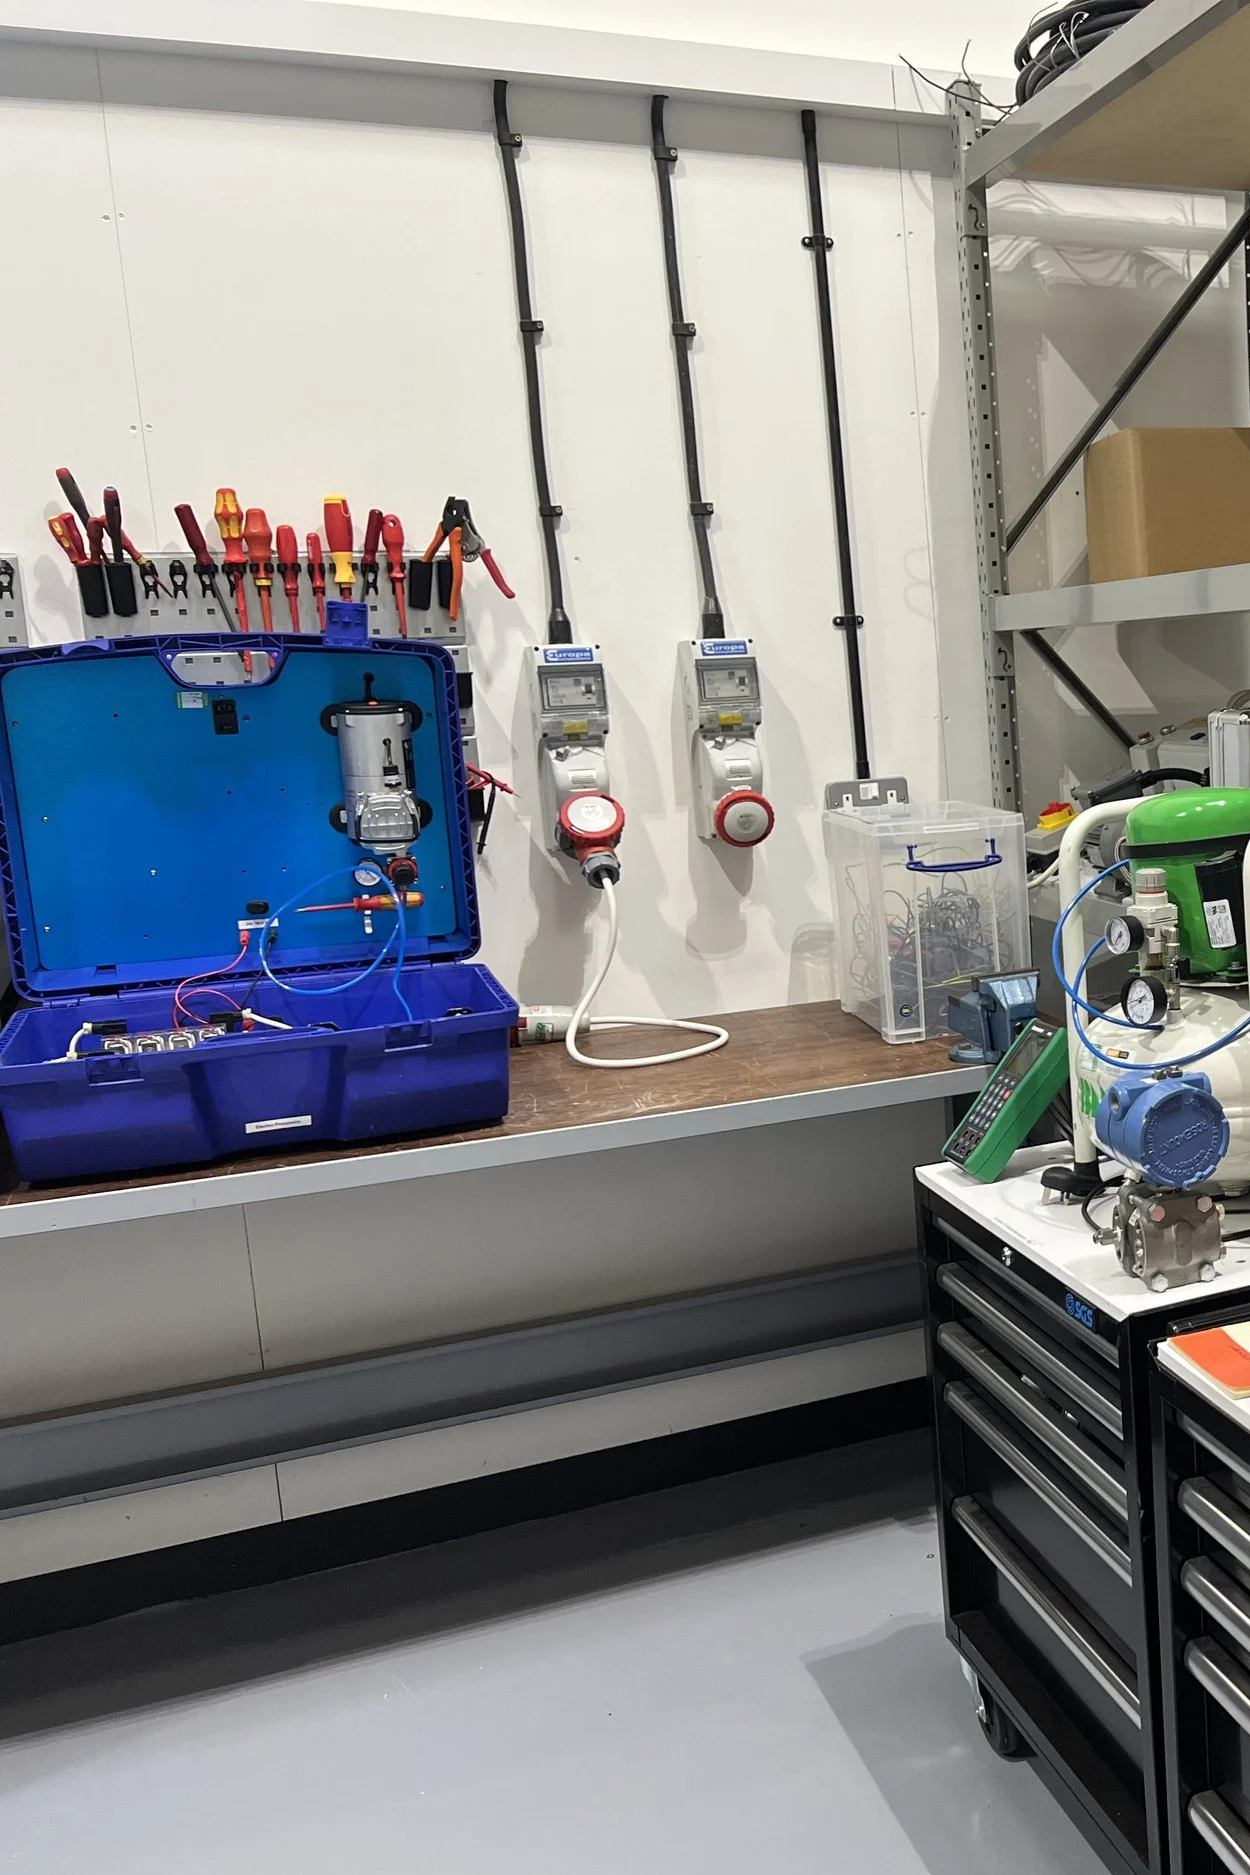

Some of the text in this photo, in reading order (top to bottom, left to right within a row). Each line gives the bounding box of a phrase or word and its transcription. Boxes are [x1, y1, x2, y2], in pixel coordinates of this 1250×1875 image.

[703, 642, 745, 654] Europa
[546, 649, 591, 661] Europa
[1075, 1300, 1093, 1328] SGS
